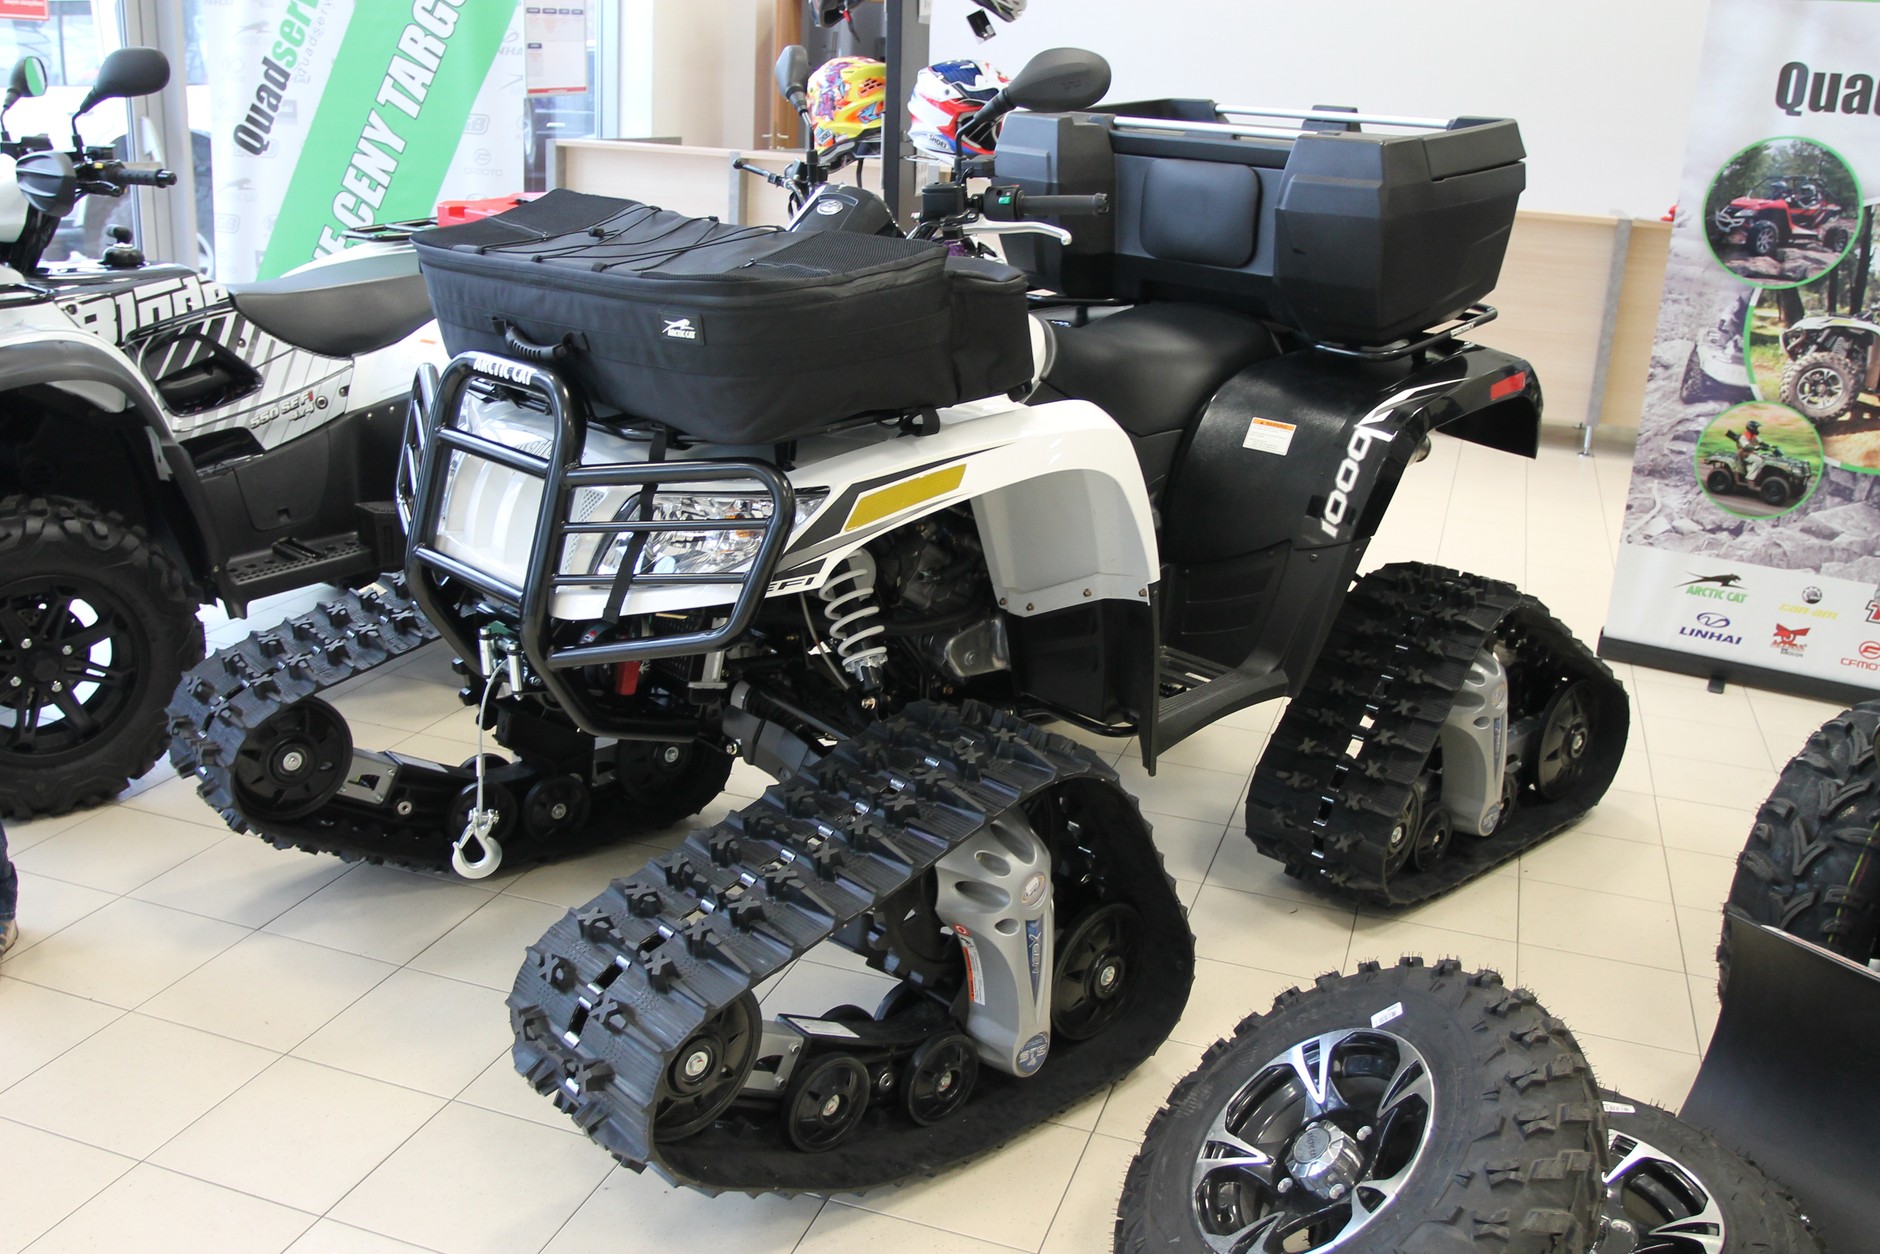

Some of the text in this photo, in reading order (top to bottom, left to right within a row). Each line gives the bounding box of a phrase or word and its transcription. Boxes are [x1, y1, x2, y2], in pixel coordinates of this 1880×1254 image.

[233, 0, 319, 156] Quadser
[1775, 61, 1880, 117] Qua
[332, 108, 407, 228] CENY
[375, 0, 466, 120] TARG
[473, 356, 538, 385] ARCTIC CAT
[250, 406, 280, 429] 550
[1320, 428, 1372, 539] 1000
[1685, 585, 1748, 603] ARCTIC CAT
[1679, 626, 1742, 645] LINHAI
[1840, 657, 1880, 671] CFMO
